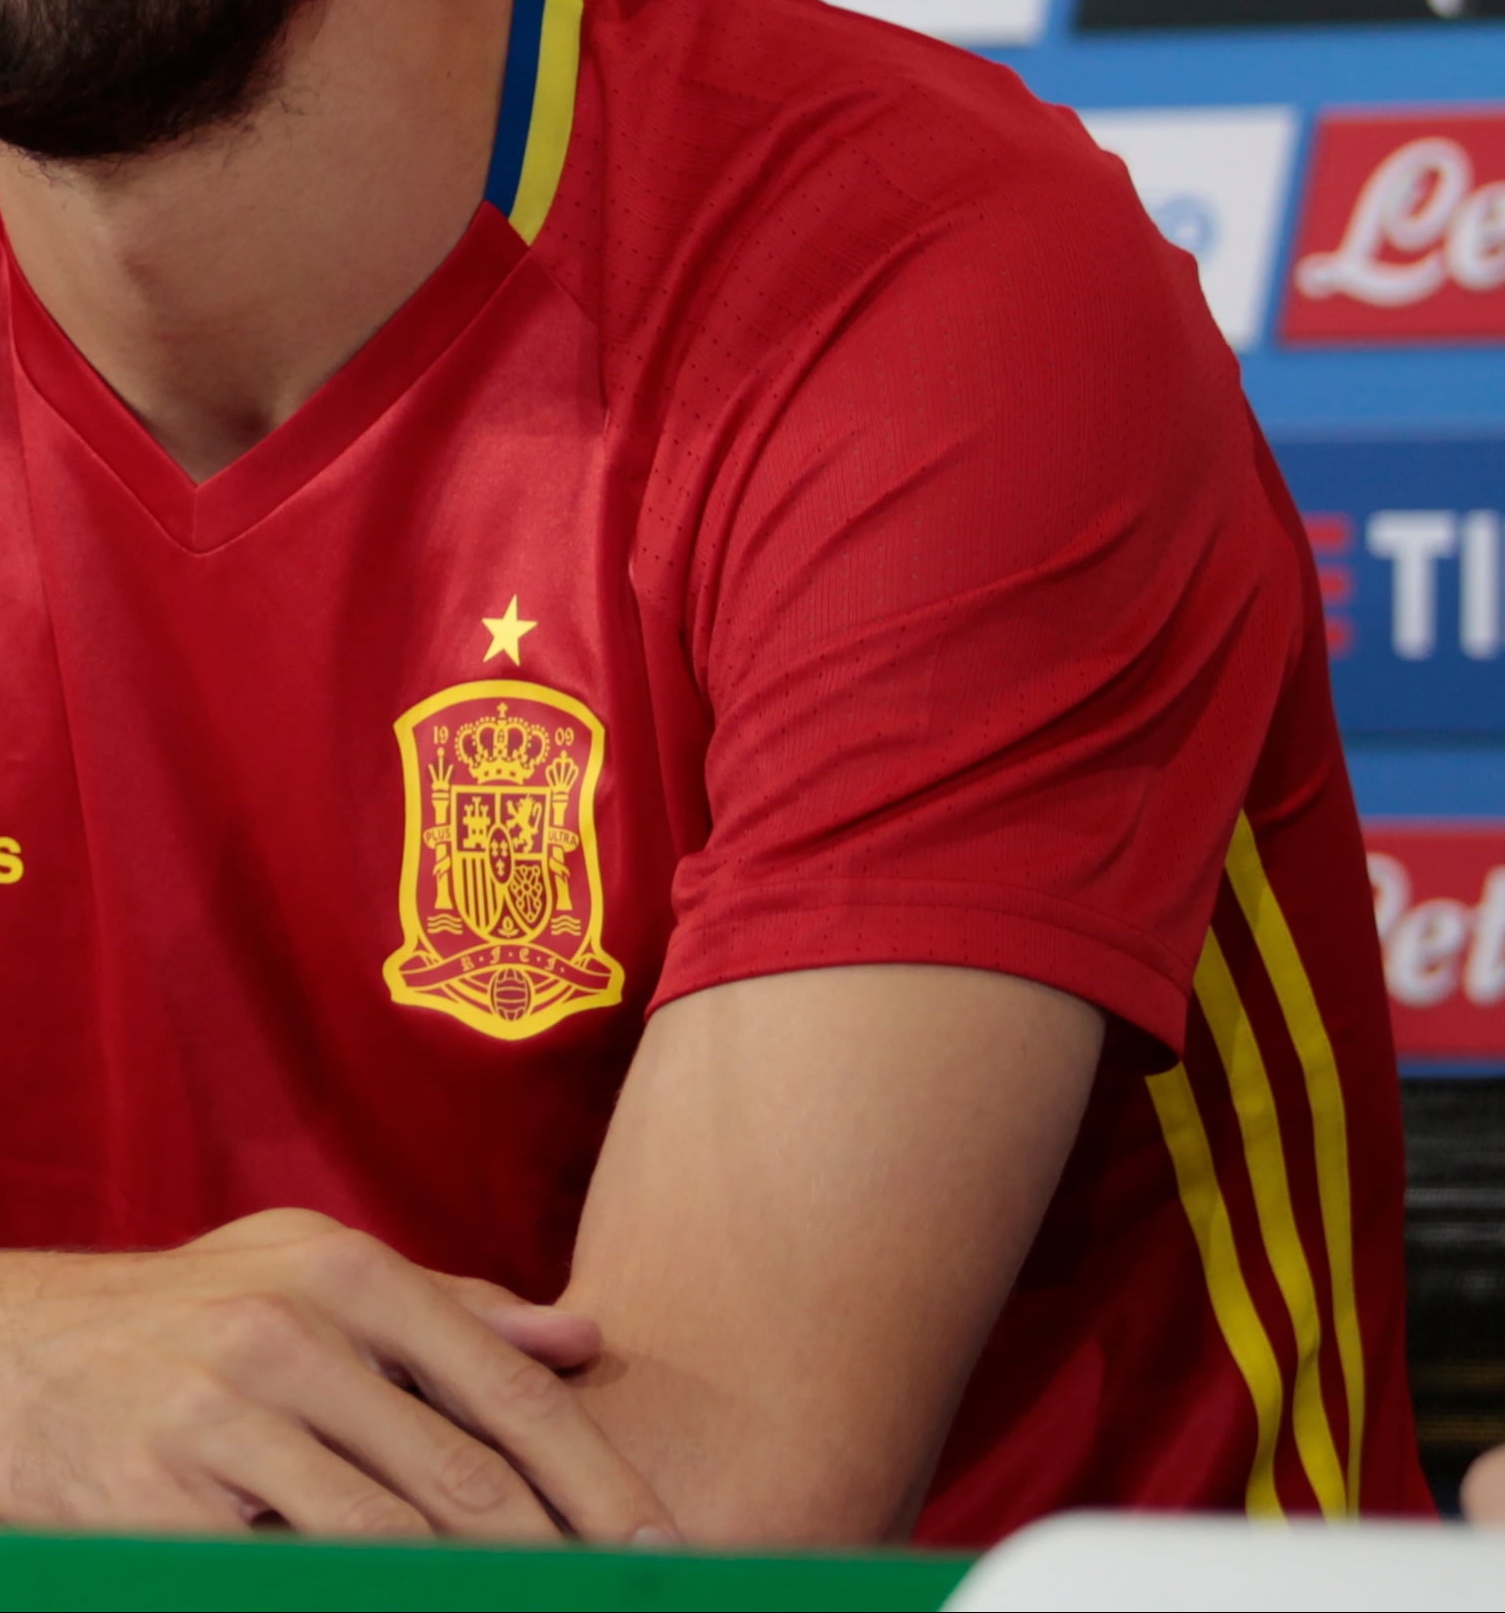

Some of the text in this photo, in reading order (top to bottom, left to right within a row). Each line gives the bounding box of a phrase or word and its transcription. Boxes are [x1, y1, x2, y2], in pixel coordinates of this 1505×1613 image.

[1365, 510, 1505, 660] TI
[433, 724, 449, 745] 19
[554, 726, 575, 747] 09
[424, 826, 452, 844] PLUS
[547, 827, 579, 846] ULTRA
